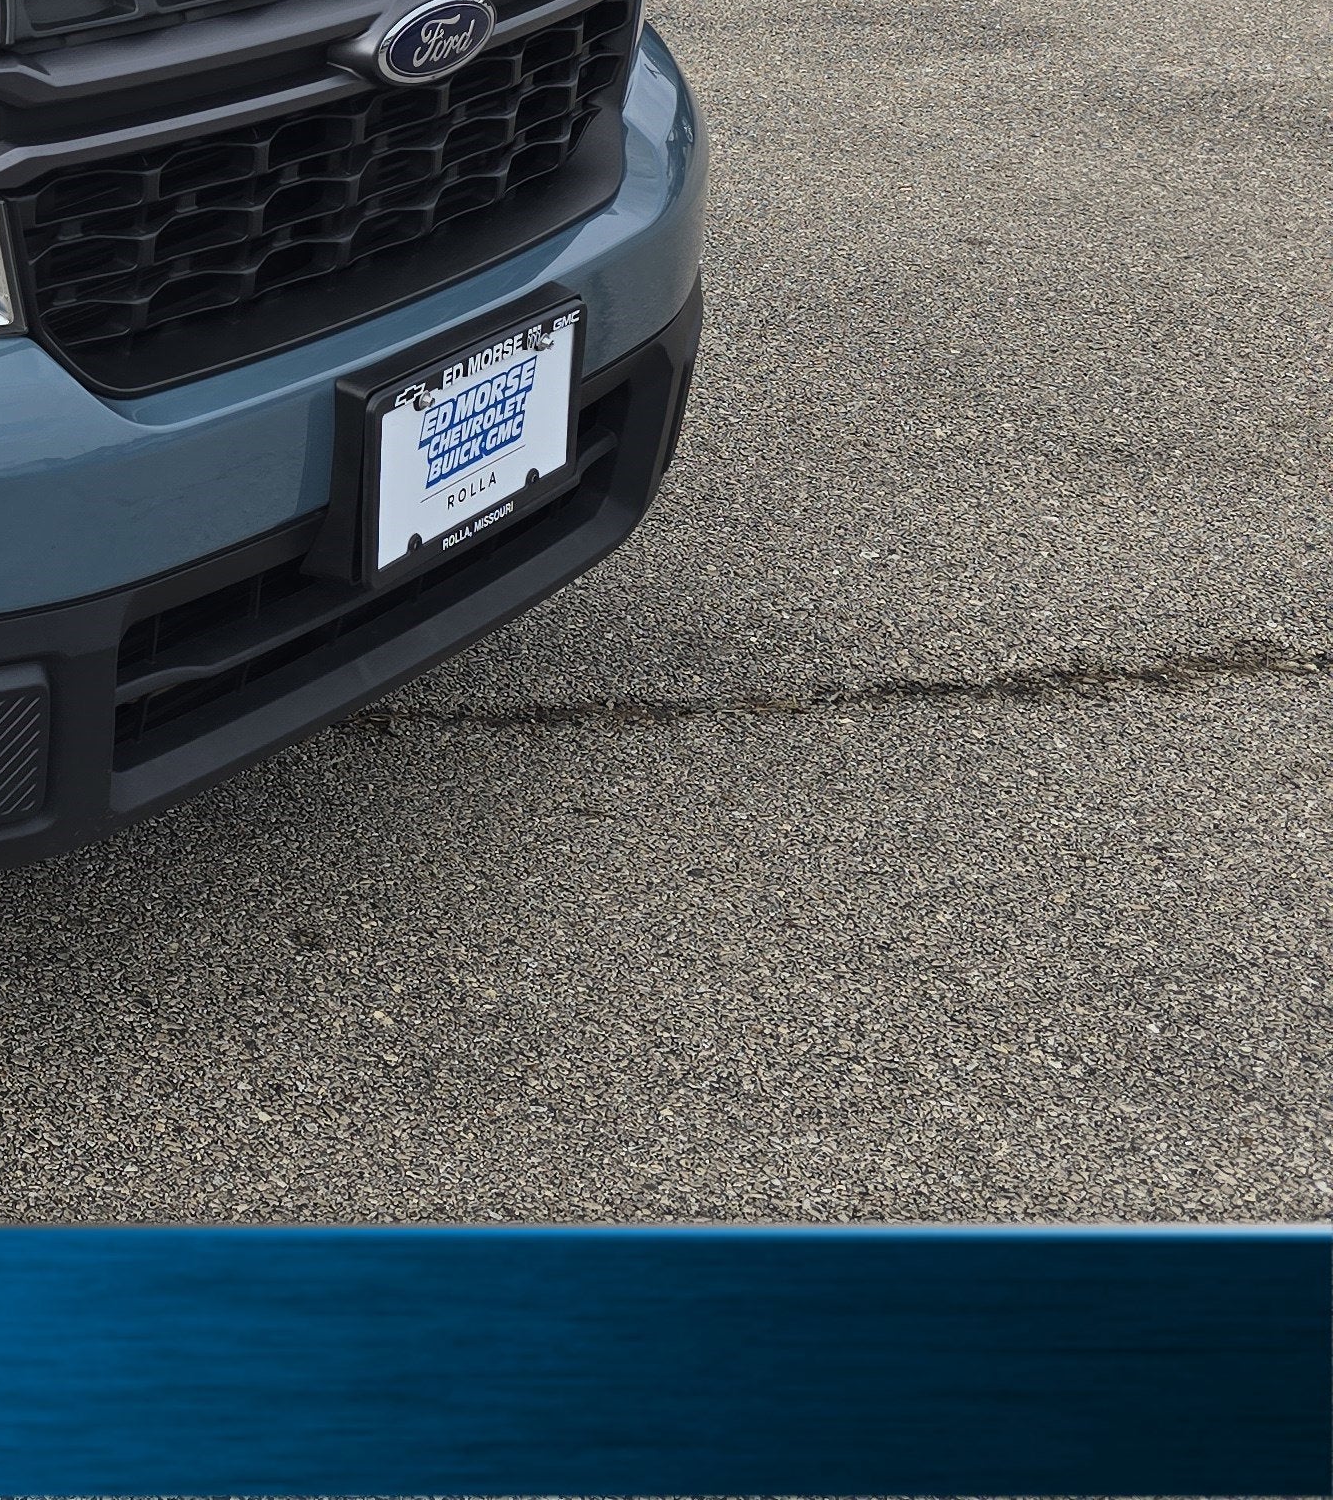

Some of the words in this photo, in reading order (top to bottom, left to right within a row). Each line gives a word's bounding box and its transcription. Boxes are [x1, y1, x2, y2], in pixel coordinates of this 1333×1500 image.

[412, 13, 476, 68] Ford
[552, 309, 581, 332] GMC
[441, 362, 464, 389] ED
[467, 333, 524, 375] MORSE
[420, 405, 454, 441] ED
[451, 361, 537, 423] MORSE
[427, 397, 525, 460] CHEVROLET
[447, 471, 497, 510] ROLLA
[442, 526, 473, 551] ROLLA,
[473, 501, 514, 533] MISSOURI
